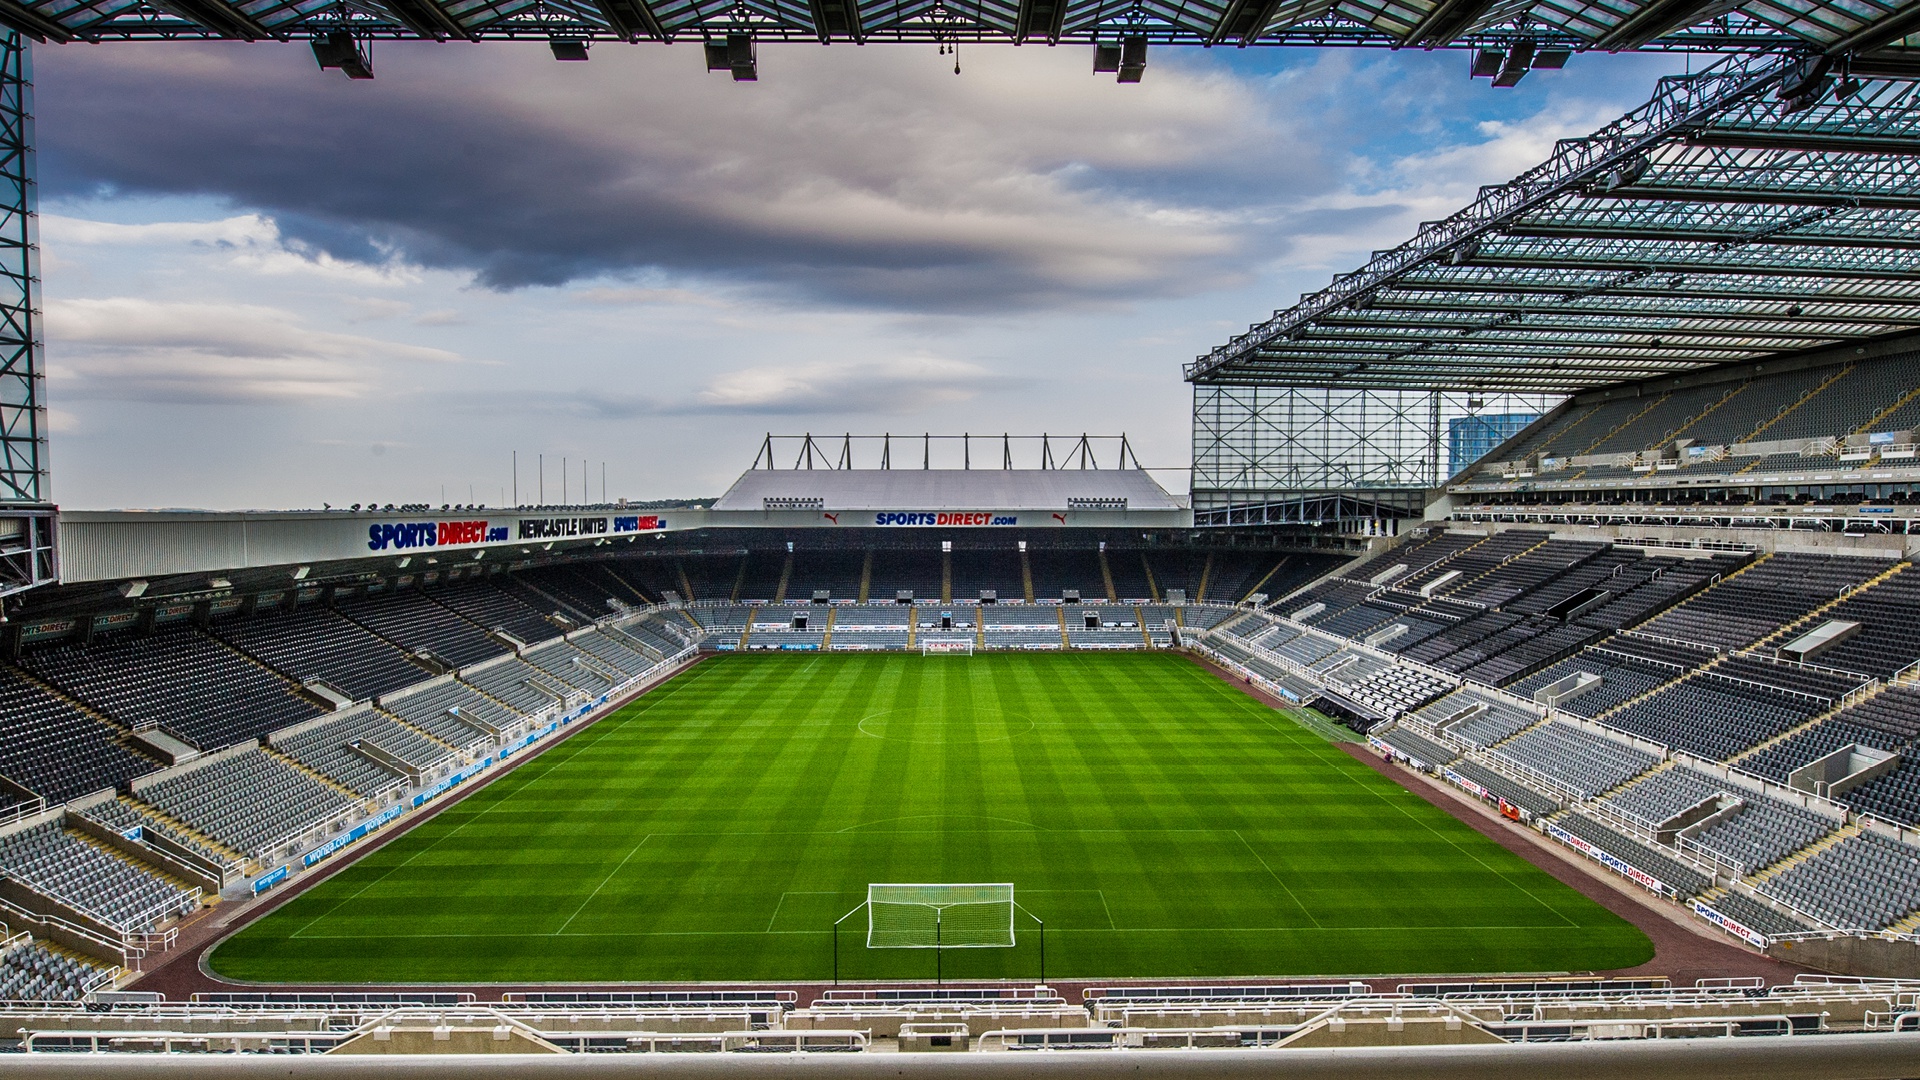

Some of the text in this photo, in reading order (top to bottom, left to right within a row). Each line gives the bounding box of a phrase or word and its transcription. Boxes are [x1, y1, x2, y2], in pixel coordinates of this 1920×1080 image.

[518, 518, 607, 539] NEWCASTLE UNITED
[364, 804, 400, 832] wonga.com
[308, 832, 351, 863] wonga.com
[258, 868, 285, 886] wonga.com
